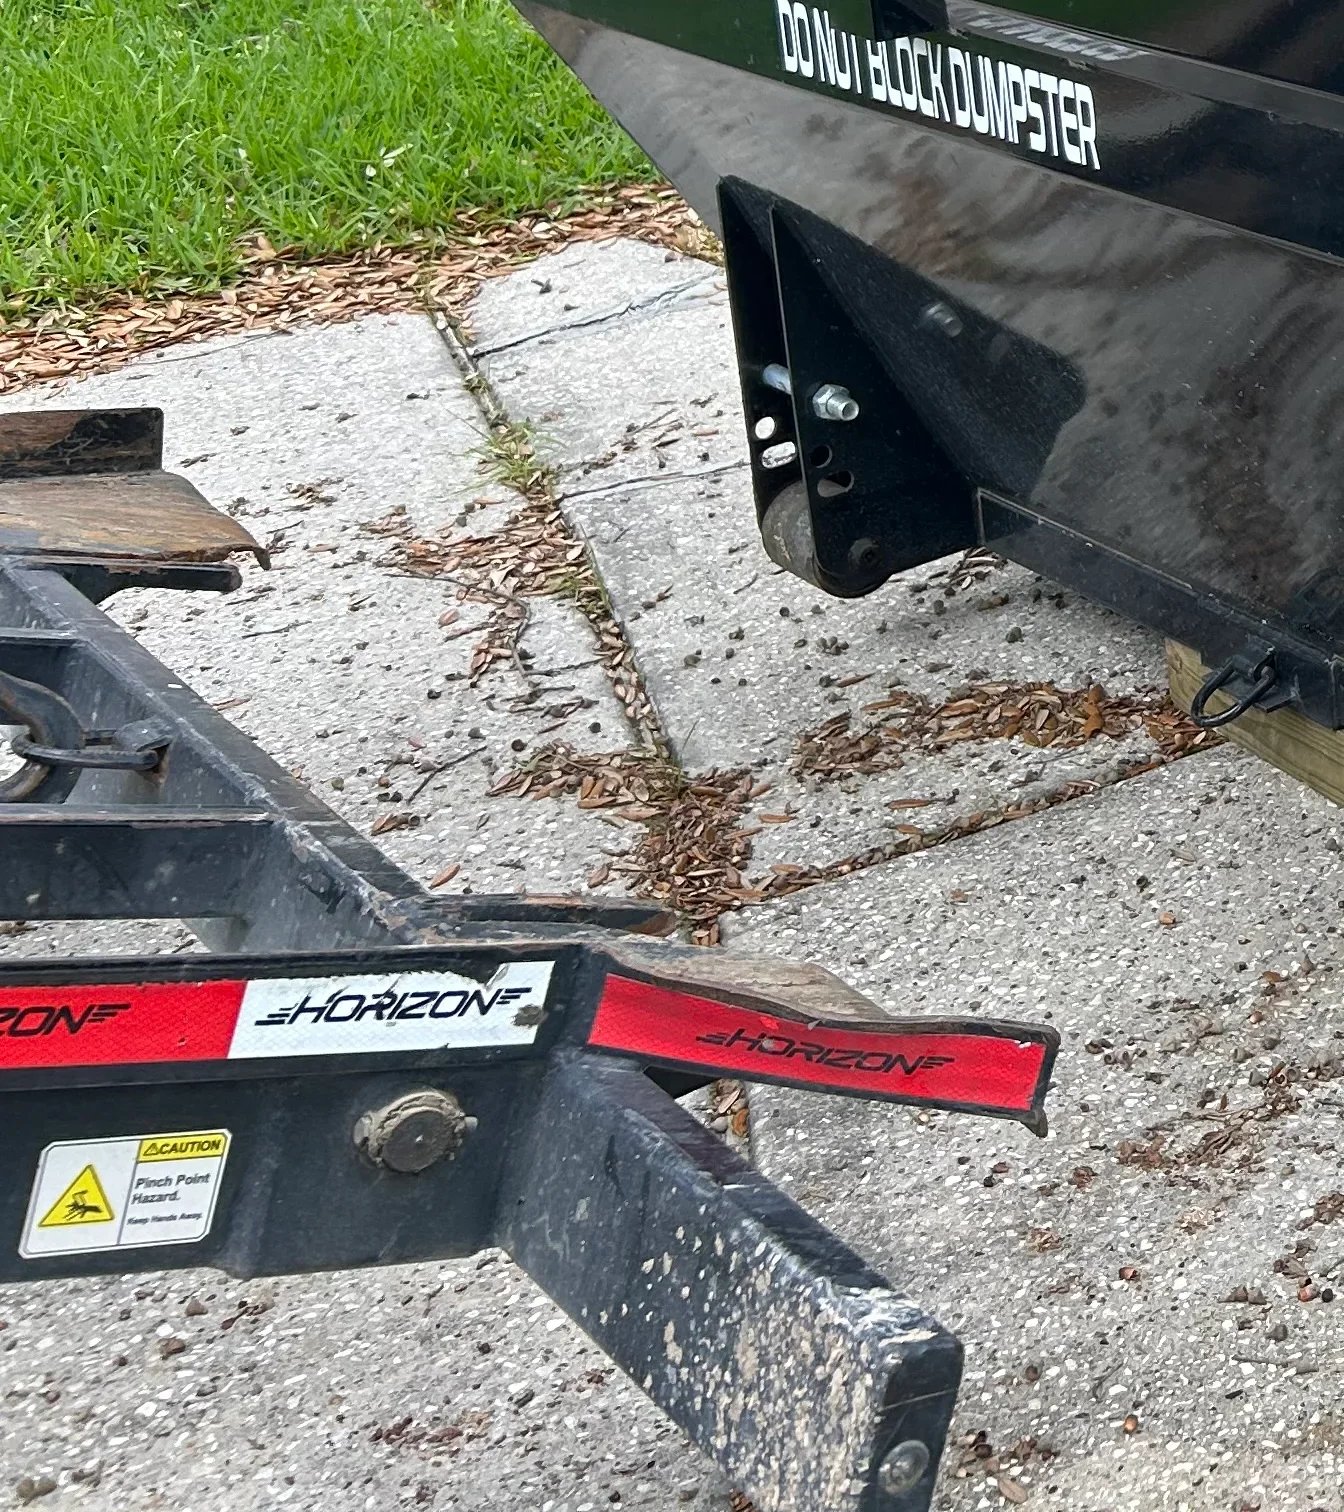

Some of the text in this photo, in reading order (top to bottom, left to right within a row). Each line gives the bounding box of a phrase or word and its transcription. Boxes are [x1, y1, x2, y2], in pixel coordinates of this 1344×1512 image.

[866, 36, 951, 123] BLOCK
[948, 46, 1101, 170] DUMPSTER
[292, 988, 504, 1026] HORIZON
[720, 1028, 932, 1076] HORIZON
[158, 1139, 222, 1156] CAUTION
[134, 1172, 211, 1189] Pinch Point
[131, 1189, 181, 1205] Hazard.
